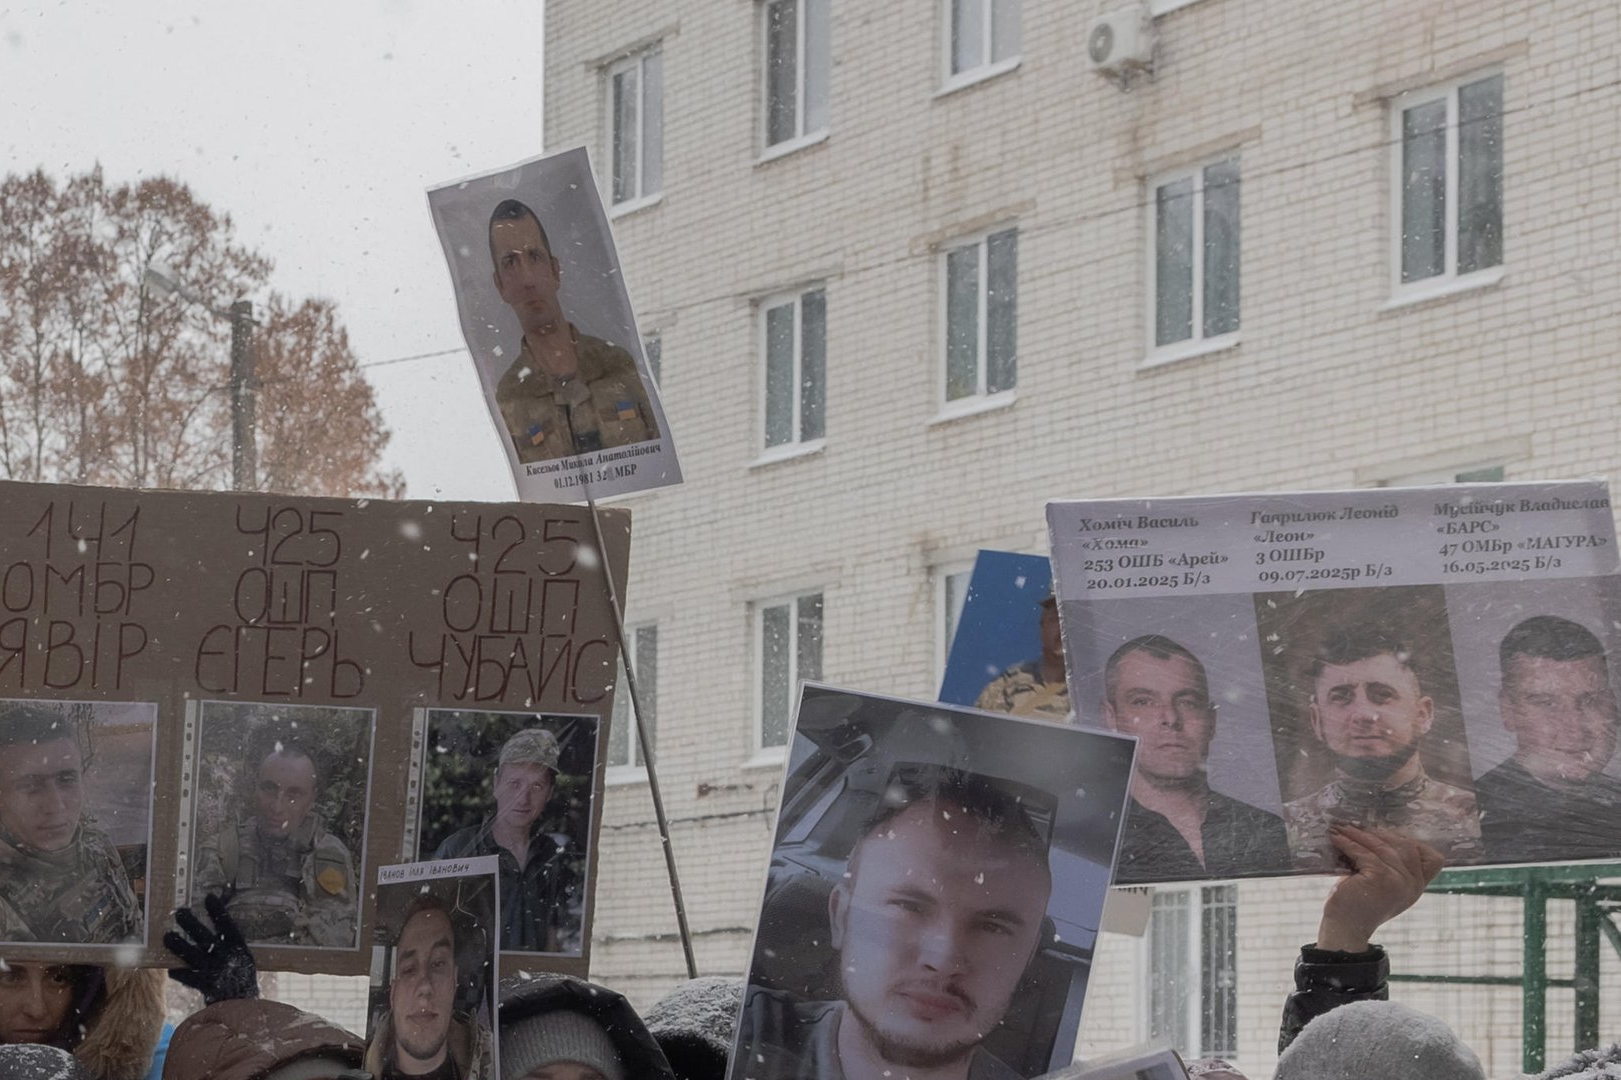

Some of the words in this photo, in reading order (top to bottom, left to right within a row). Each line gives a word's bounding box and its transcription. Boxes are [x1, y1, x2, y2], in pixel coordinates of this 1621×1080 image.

[1250, 511, 1336, 526] Гаврилюк
[1339, 505, 1399, 520] Леонід
[1520, 498, 1610, 513] Владислав
[1079, 518, 1132, 532] Хоміч
[1137, 515, 1198, 529] Василь
[1437, 521, 1500, 535] «БАРС»
[236, 504, 344, 567] 425
[451, 515, 581, 576] 425
[1254, 530, 1314, 543] «Леон»
[1269, 548, 1325, 563] ОШБр
[1439, 543, 1458, 557] 47
[1462, 540, 1512, 554] ОМБр
[1084, 559, 1113, 573] 253
[1118, 554, 1164, 569] ОШБ
[1168, 551, 1229, 568] «Арей»
[1443, 558, 1530, 574] 16.05.2025
[1535, 555, 1562, 570] Б/з
[1087, 574, 1178, 590] 20.01.2025
[1183, 571, 1211, 588] Б/з
[1259, 568, 1361, 584] 09.07.2025р
[1365, 563, 1393, 580] Б/з
[2, 561, 155, 616] ОМБР
[234, 567, 338, 627] ОШП
[443, 574, 580, 635] ОШП
[408, 632, 610, 704] ЧУБАЙС
